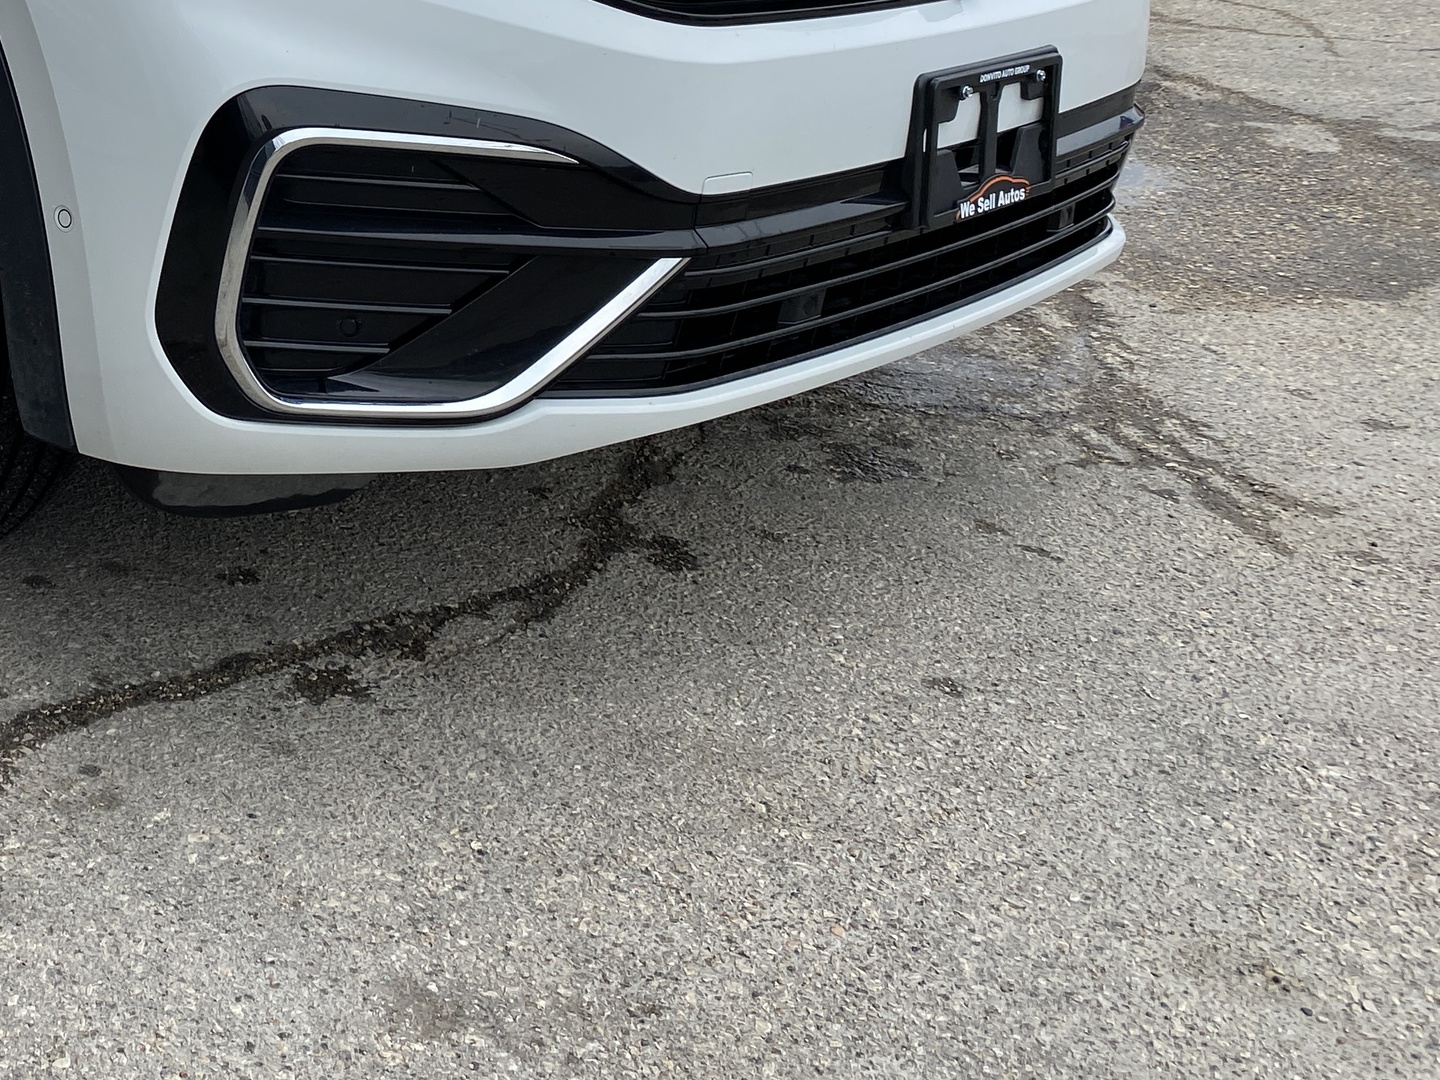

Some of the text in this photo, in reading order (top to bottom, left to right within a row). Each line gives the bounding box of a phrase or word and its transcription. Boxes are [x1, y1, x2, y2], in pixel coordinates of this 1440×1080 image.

[1002, 67, 1015, 78] AUTO
[1014, 64, 1030, 75] GROUP
[960, 188, 1026, 219] We Sell Autos
